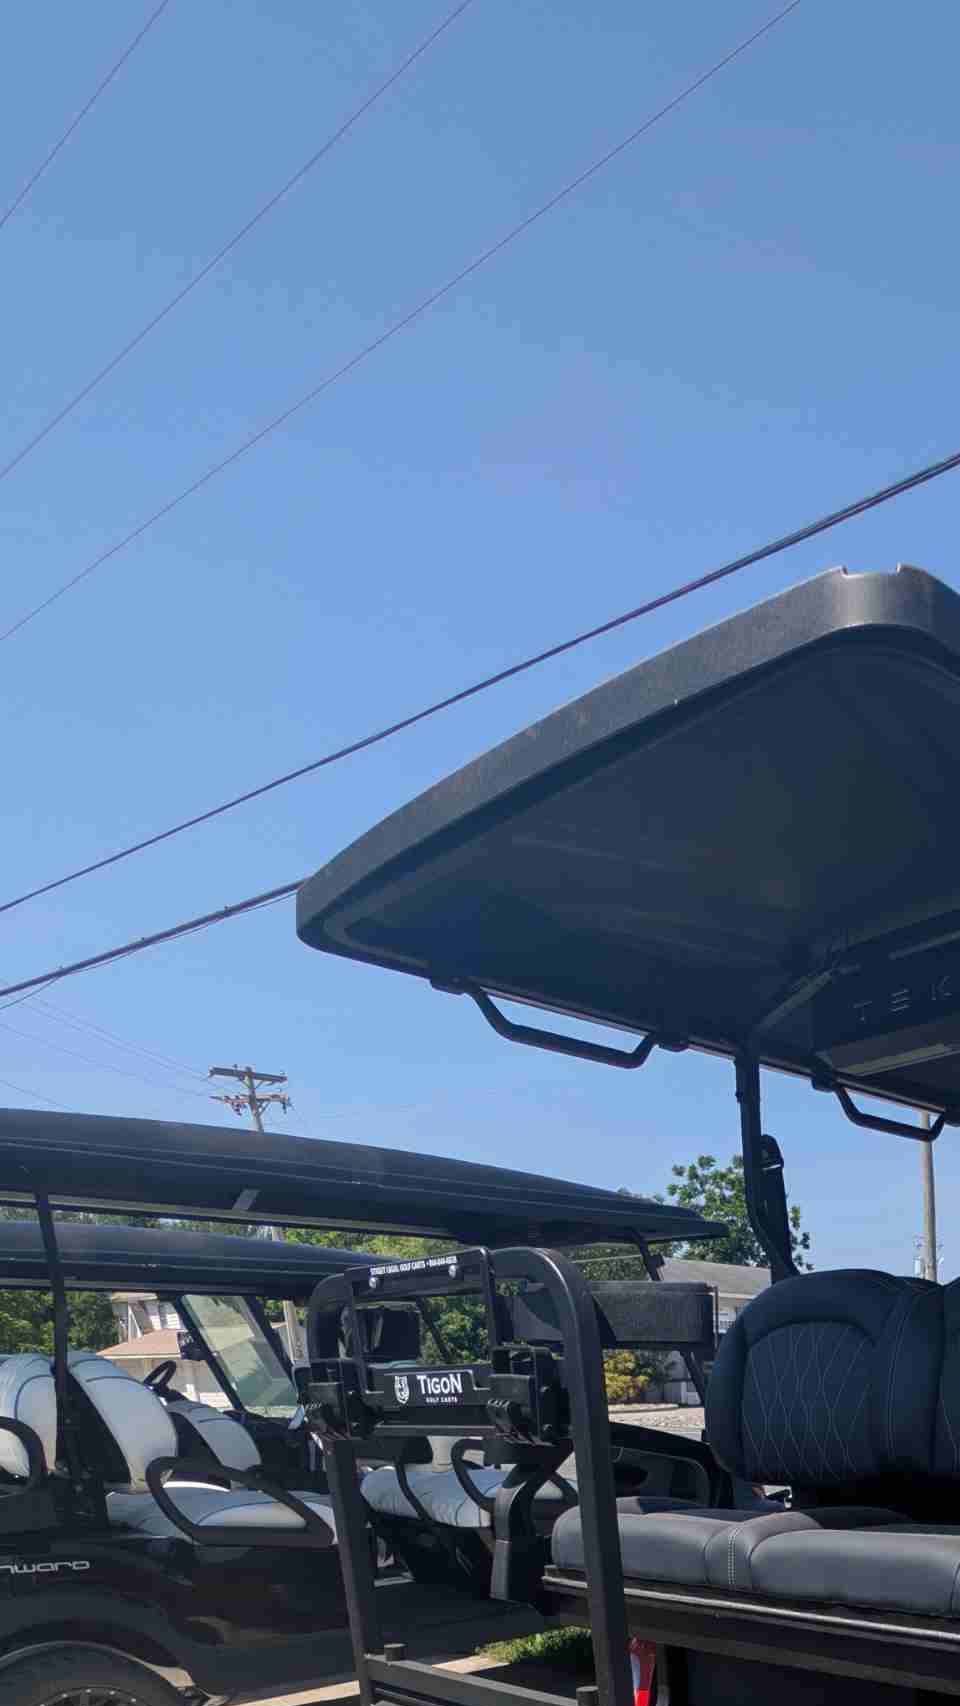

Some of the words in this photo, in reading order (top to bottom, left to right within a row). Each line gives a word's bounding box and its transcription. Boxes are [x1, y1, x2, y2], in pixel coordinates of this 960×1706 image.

[400, 1262, 410, 1271] GOLF
[411, 1260, 425, 1270] CARTS
[416, 1373, 463, 1395] TIGON
